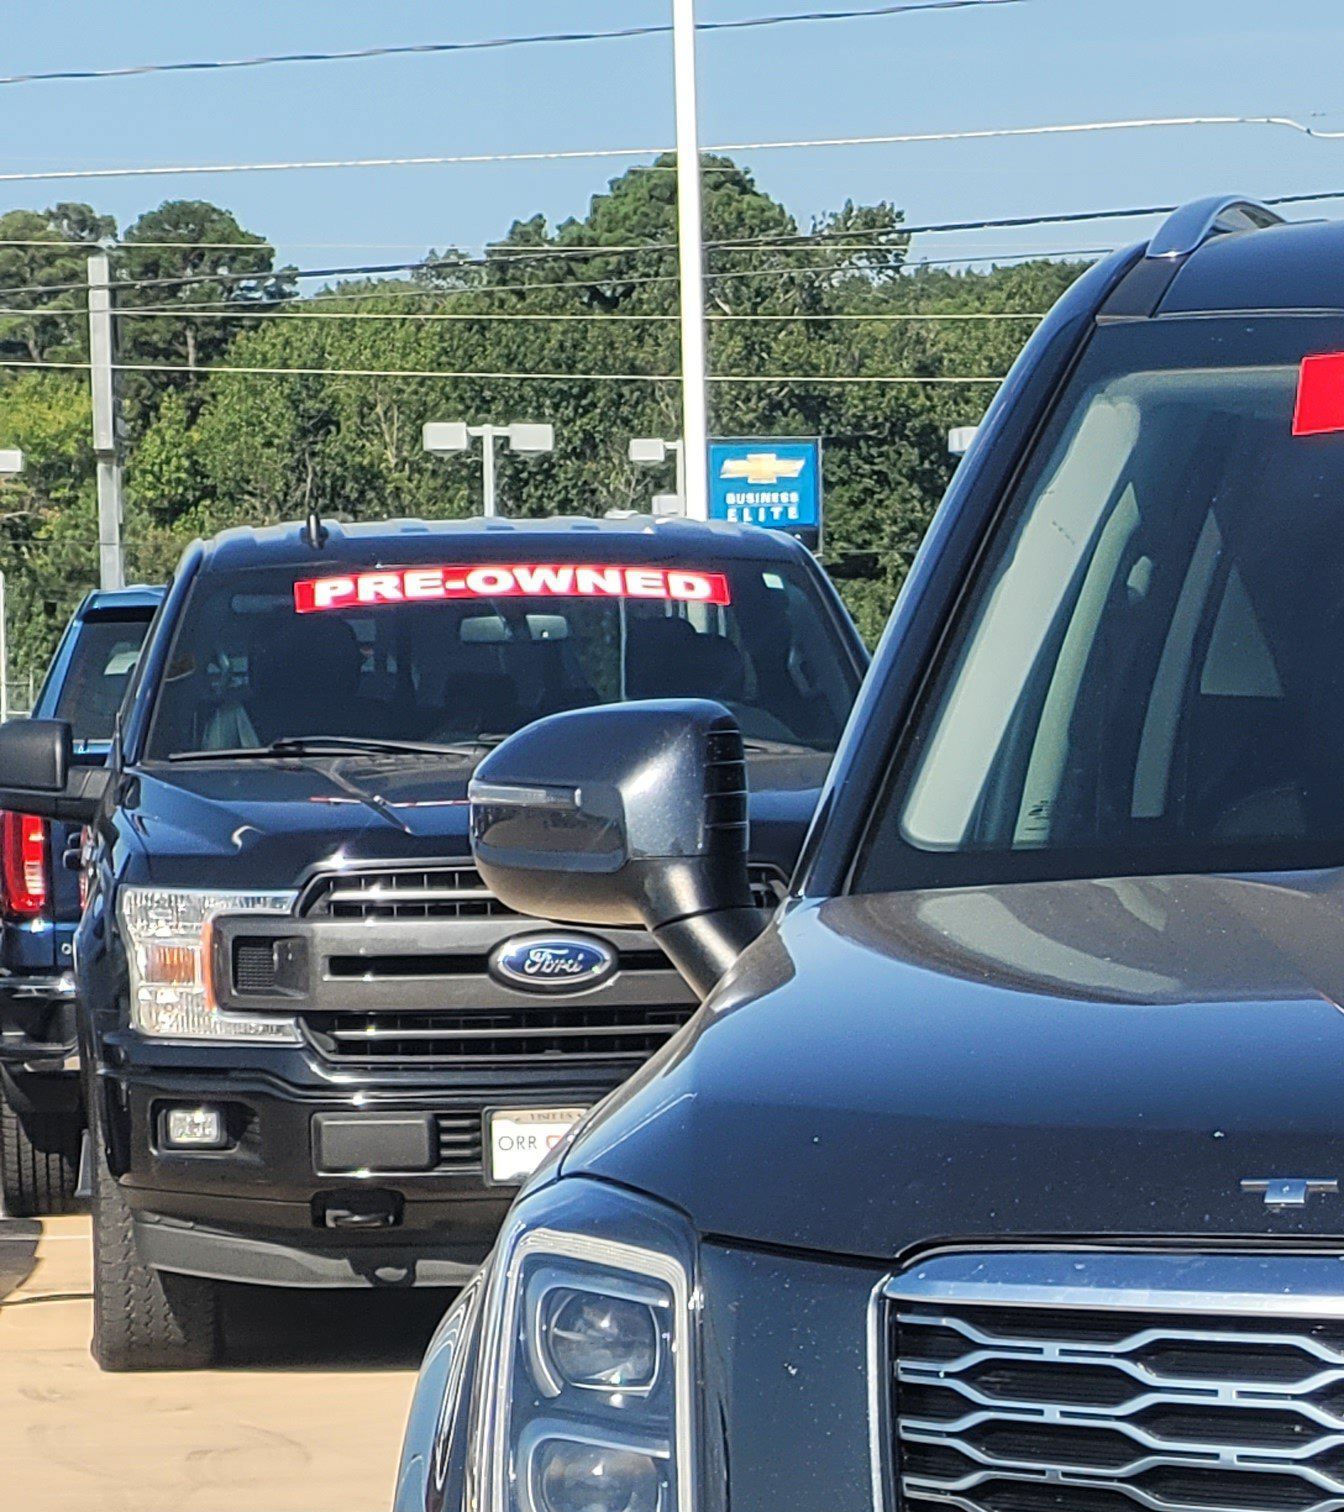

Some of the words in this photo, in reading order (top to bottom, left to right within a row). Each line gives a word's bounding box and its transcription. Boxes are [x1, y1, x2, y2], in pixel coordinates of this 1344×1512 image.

[725, 492, 799, 505] BUSINESS
[727, 507, 799, 522] ELITE
[313, 566, 712, 607] PRE-OWNED
[524, 948, 585, 974] Ford
[498, 1135, 537, 1151] ORR
